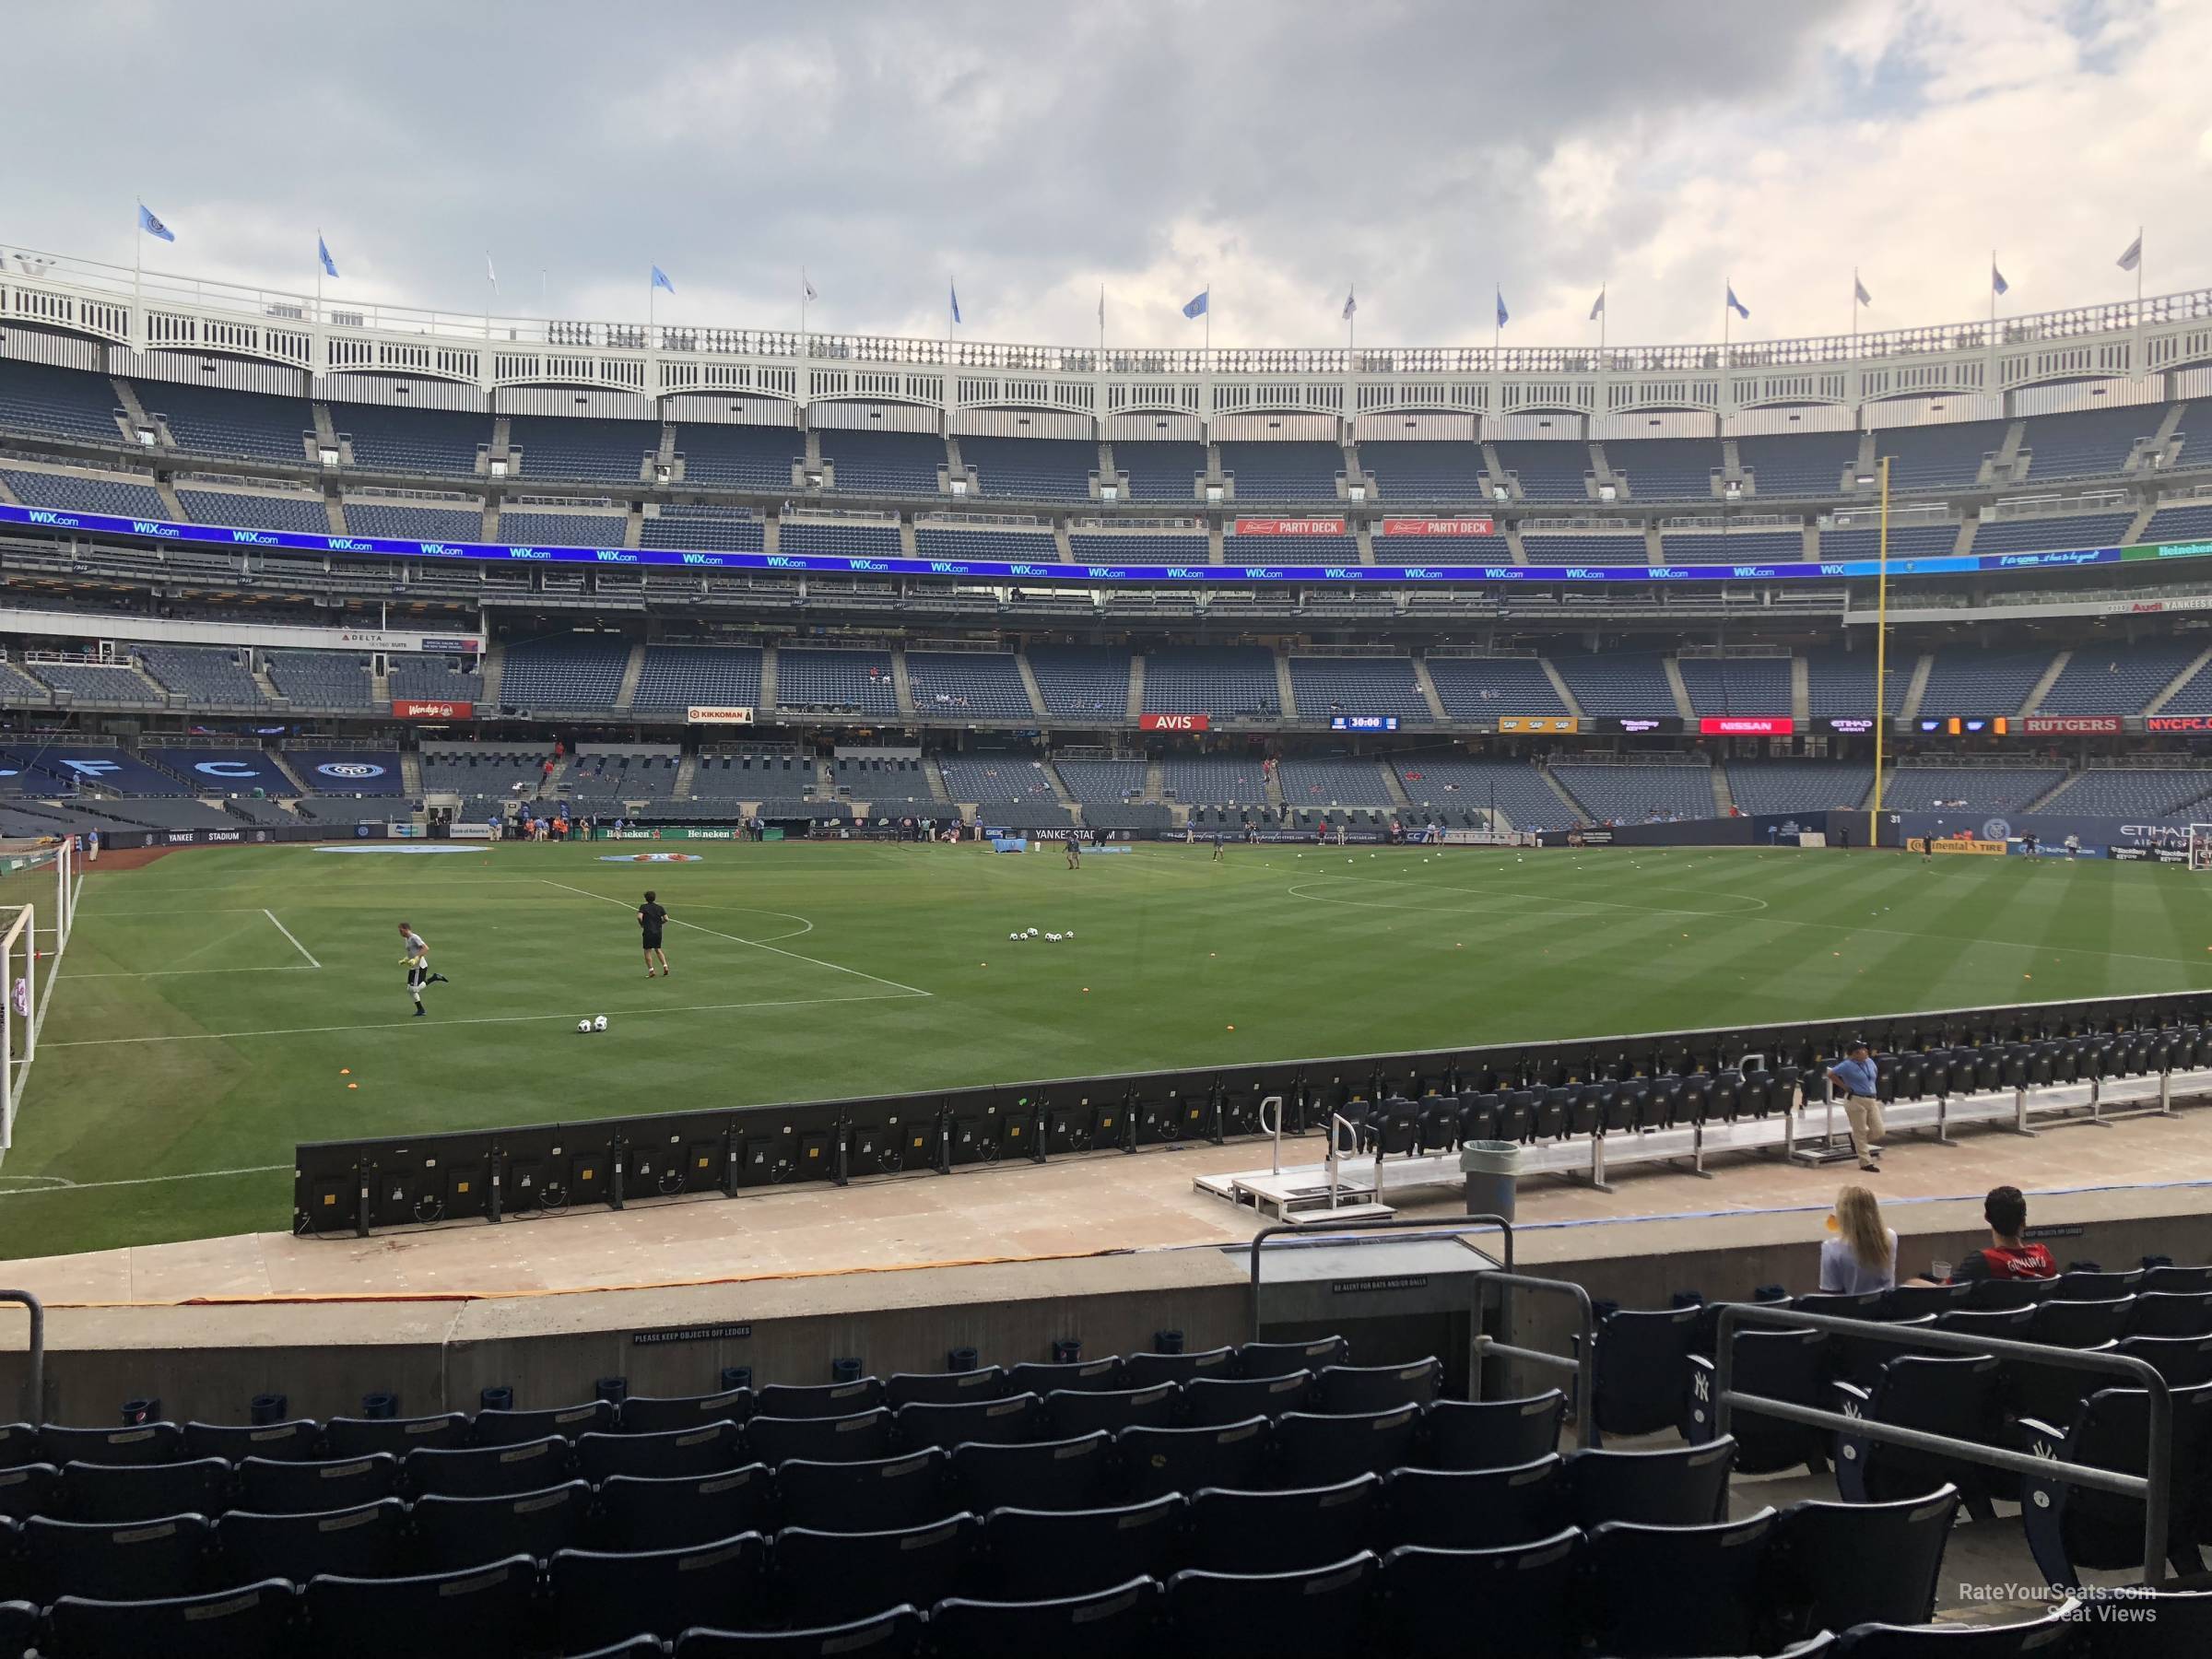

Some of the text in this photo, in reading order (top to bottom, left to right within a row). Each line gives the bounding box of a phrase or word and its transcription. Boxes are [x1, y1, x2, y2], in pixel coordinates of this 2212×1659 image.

[1279, 522, 1310, 533] PARTY
[1312, 522, 1337, 533] DECK
[1428, 522, 1458, 533] PARTY
[1460, 522, 1487, 533] DECK
[2159, 542, 2212, 557] Heineken
[2132, 602, 2162, 612] Audi
[2166, 599, 2206, 610] YANKEES
[408, 703, 440, 716] Wendy's
[701, 711, 743, 719] KIKKOMAN
[1155, 716, 1192, 728] AVIS
[1351, 718, 1381, 727] 30:00
[1720, 722, 1771, 731] NISSAN
[2027, 719, 2117, 731] RUTGERS
[59, 759, 123, 776] F
[194, 761, 261, 777] C
[169, 832, 240, 842] YANKEE STADIUM
[606, 830, 650, 838] Heneken
[688, 830, 730, 838] Heineken
[2121, 825, 2197, 838] ETIHAD
[1980, 843, 2003, 853] TIRE
[635, 1327, 750, 1343] PLEASE KEEP OBJECTS OFF LEDGES
